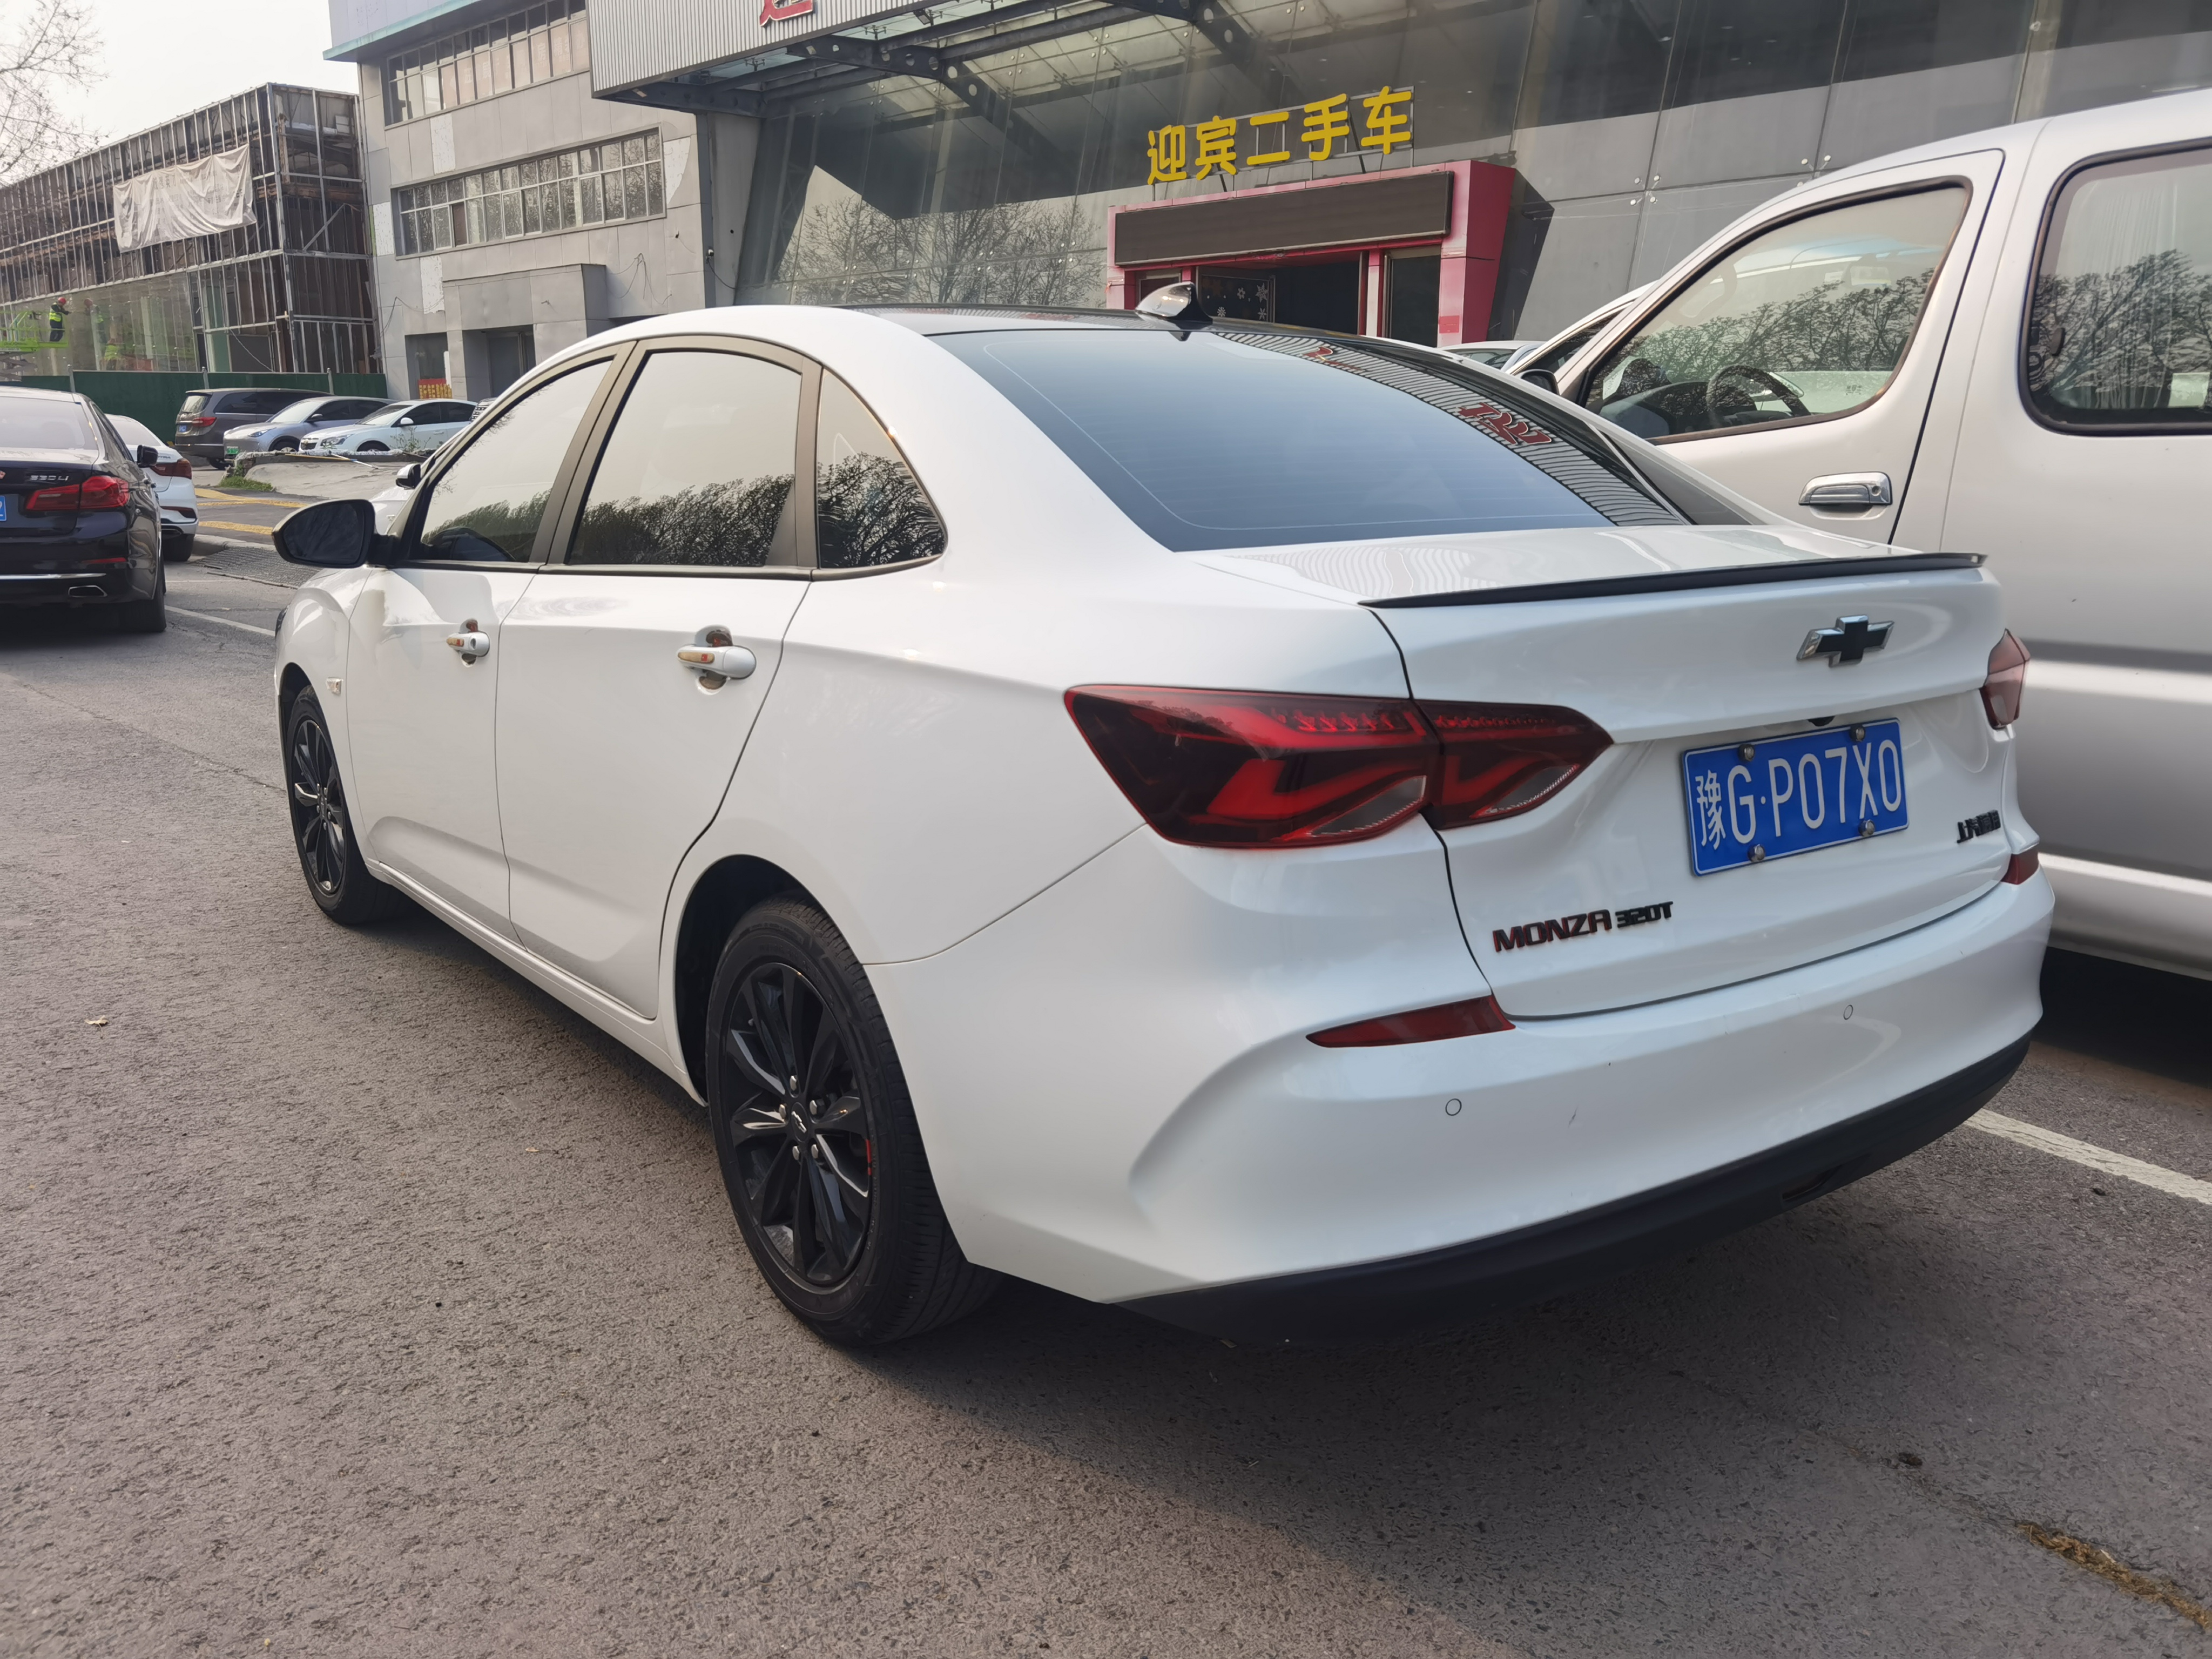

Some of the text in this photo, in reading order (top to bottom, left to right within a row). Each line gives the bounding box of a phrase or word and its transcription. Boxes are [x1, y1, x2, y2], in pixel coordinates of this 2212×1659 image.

[1147, 86, 1412, 185] 迎宾二手车
[1493, 901, 1673, 952] MONZA 320T
